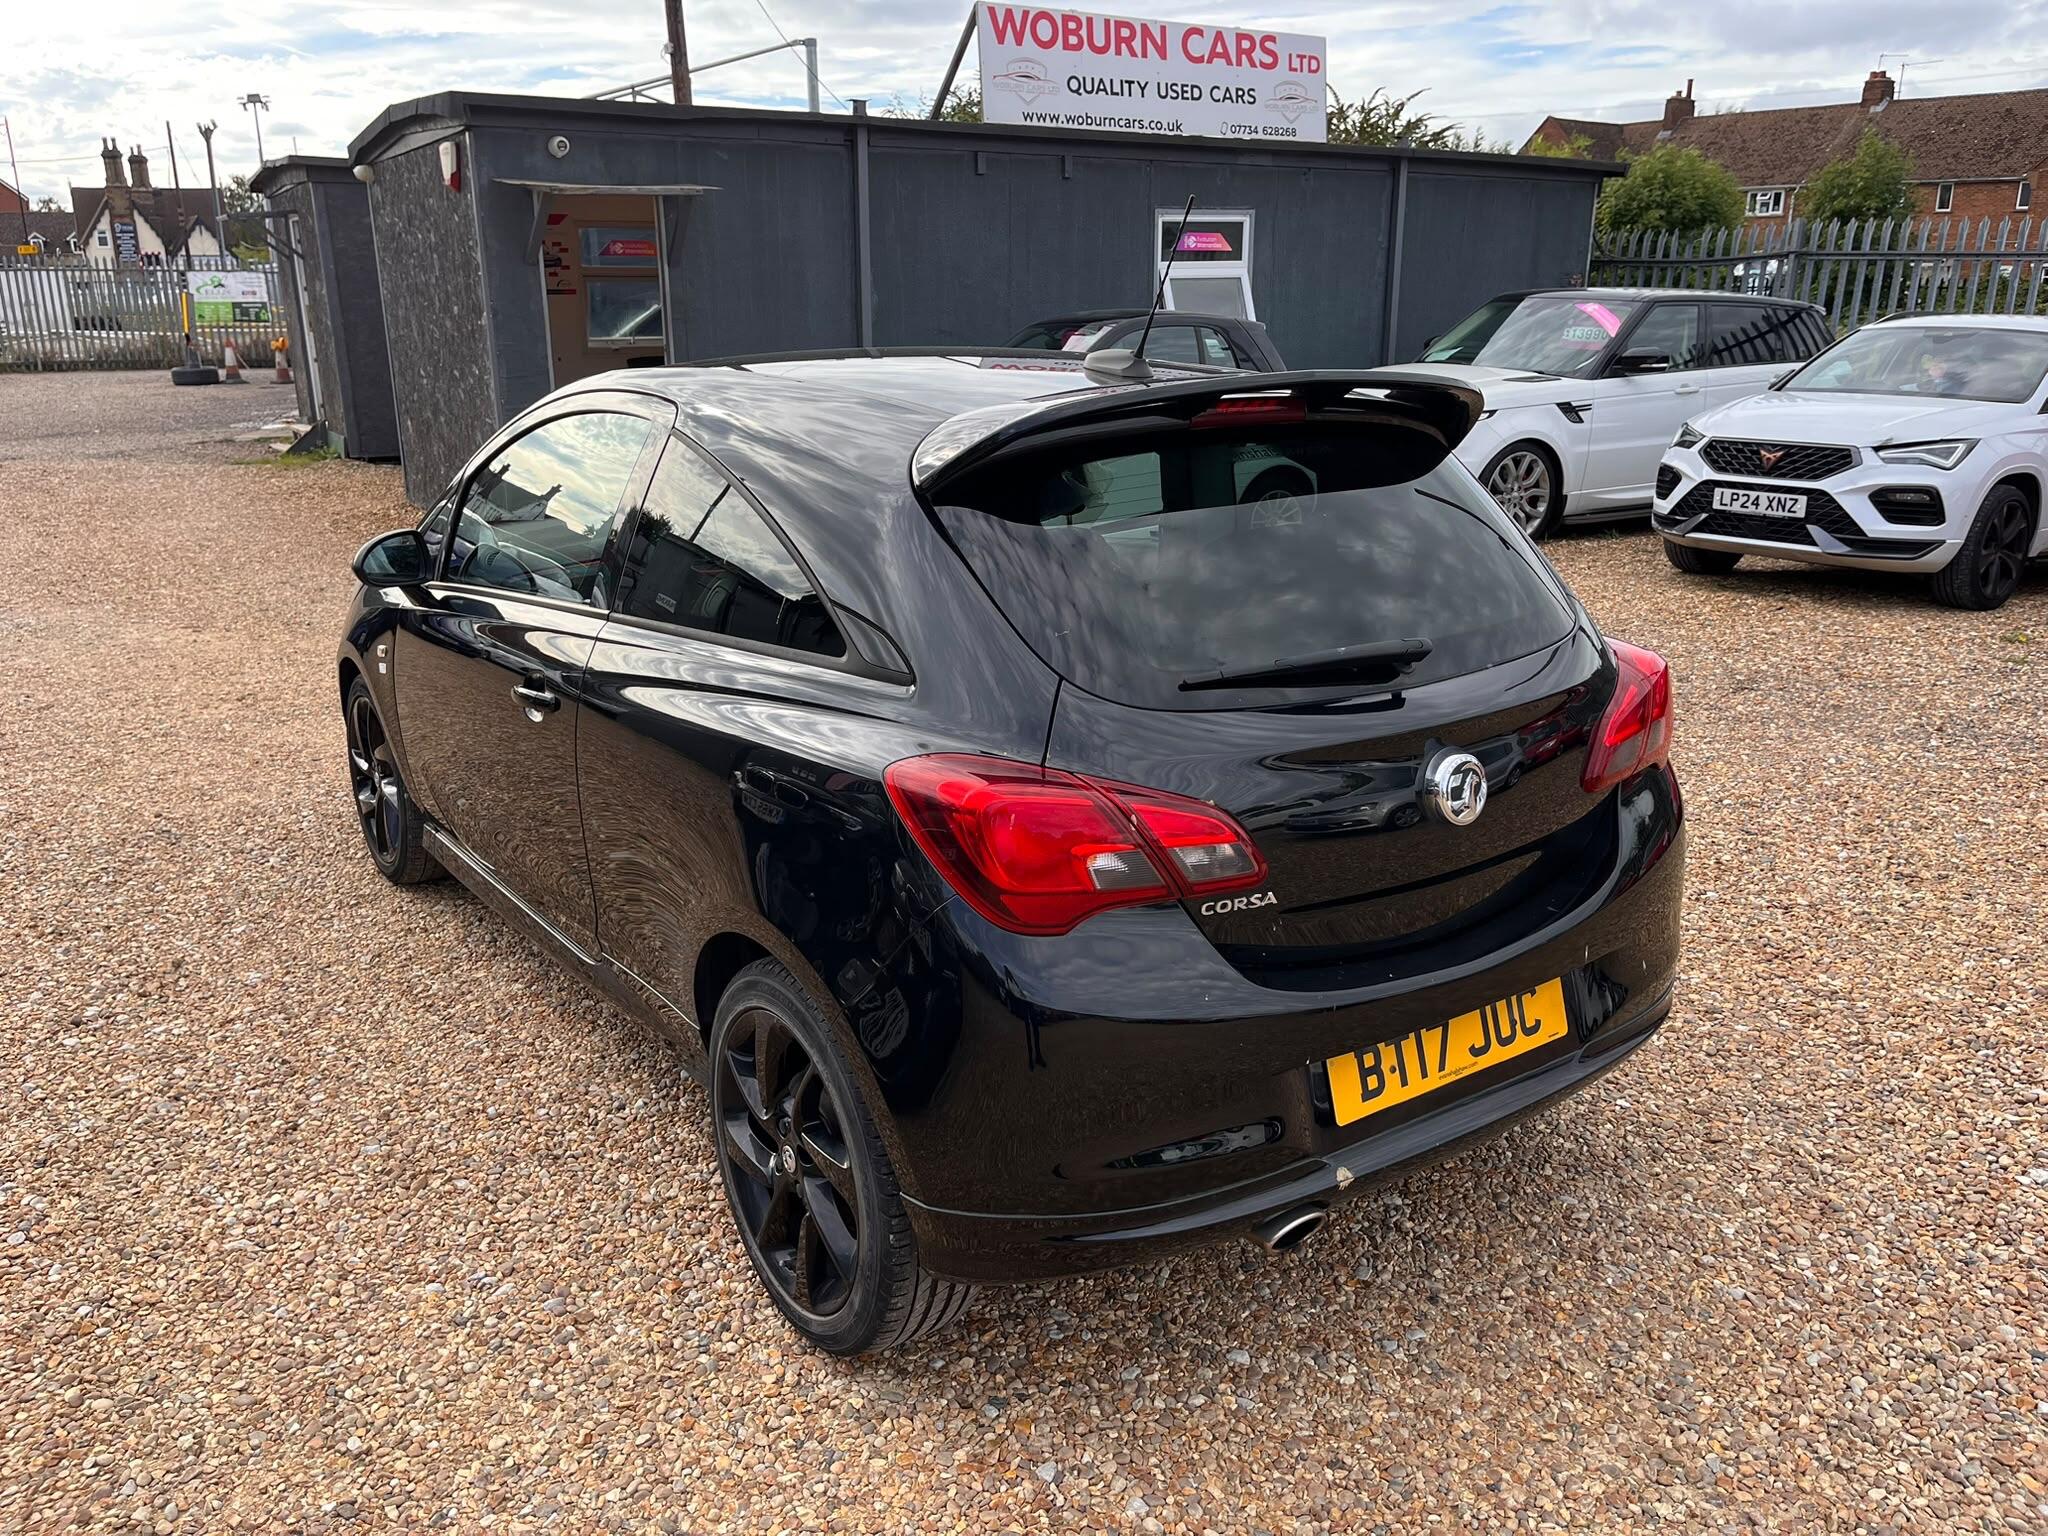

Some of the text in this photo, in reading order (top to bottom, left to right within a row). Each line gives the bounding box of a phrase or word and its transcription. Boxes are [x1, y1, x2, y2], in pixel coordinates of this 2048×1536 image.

[987, 6, 1321, 74] WOBURN CARS LTD
[1066, 75, 1257, 105] QUALITY USED CARS
[1022, 111, 1183, 132] www.woburncars.co.uk
[1230, 124, 1297, 137] 07734 628268
[1719, 490, 1799, 514] LP24 XNZ
[1201, 891, 1278, 915] CORSA
[1353, 987, 1541, 1103] BT17 JUC
